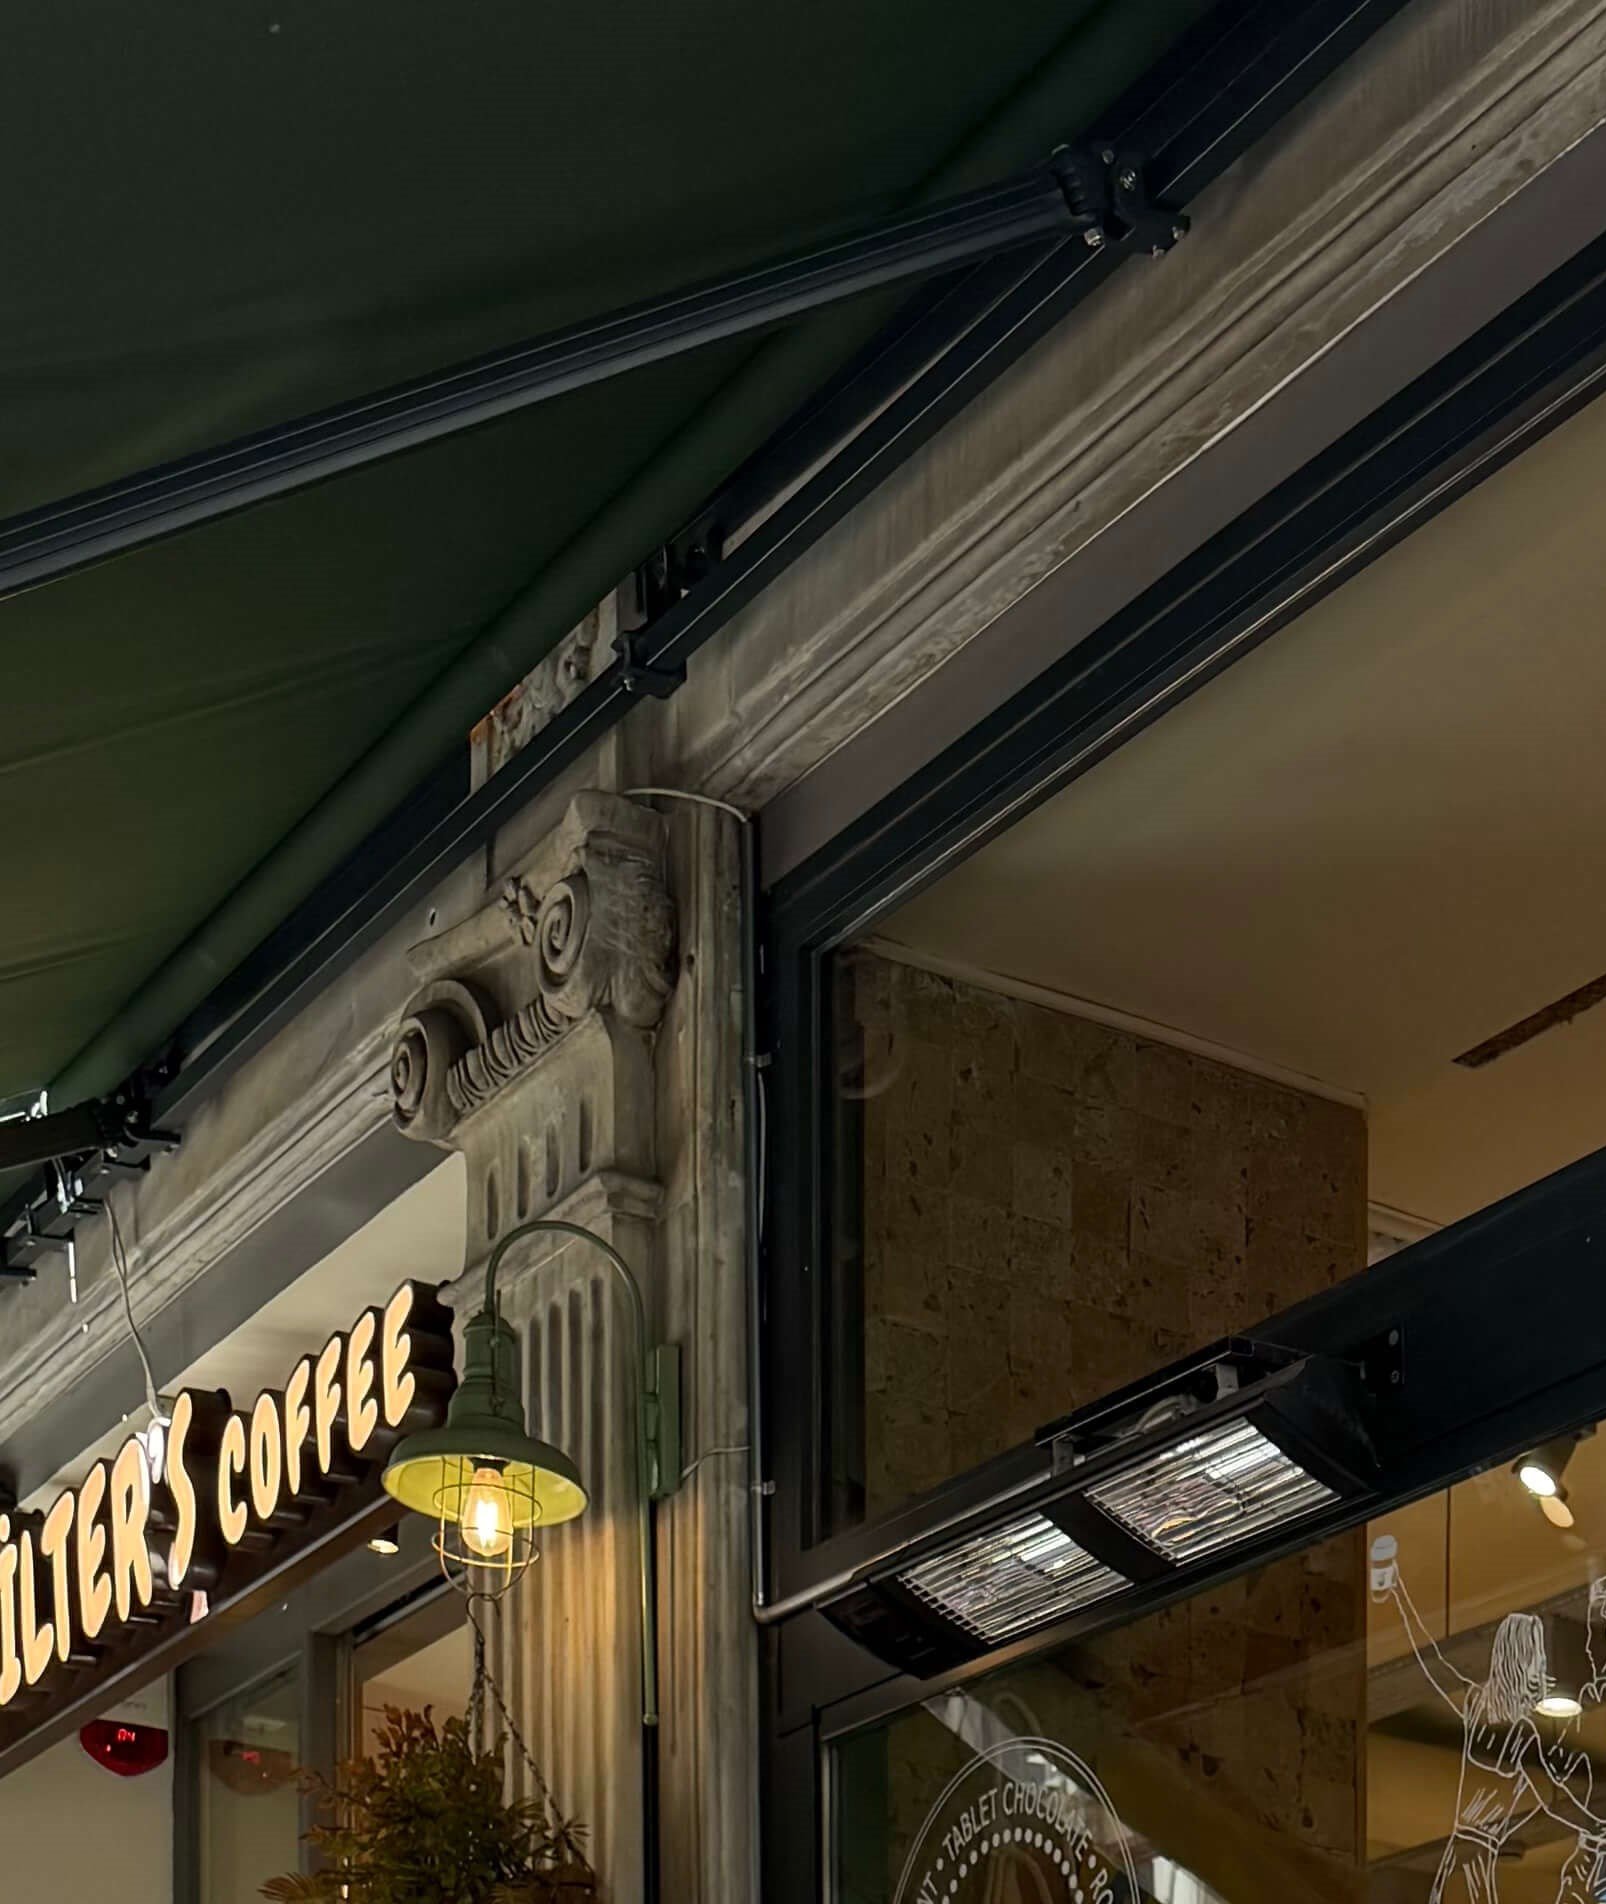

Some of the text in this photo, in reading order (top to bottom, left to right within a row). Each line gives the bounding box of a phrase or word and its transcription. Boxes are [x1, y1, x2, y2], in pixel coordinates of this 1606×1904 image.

[218, 1284, 415, 1544] COFFEE
[941, 1787, 998, 1861] TABLET
[1002, 1781, 1092, 1861] CHOCOLATE
